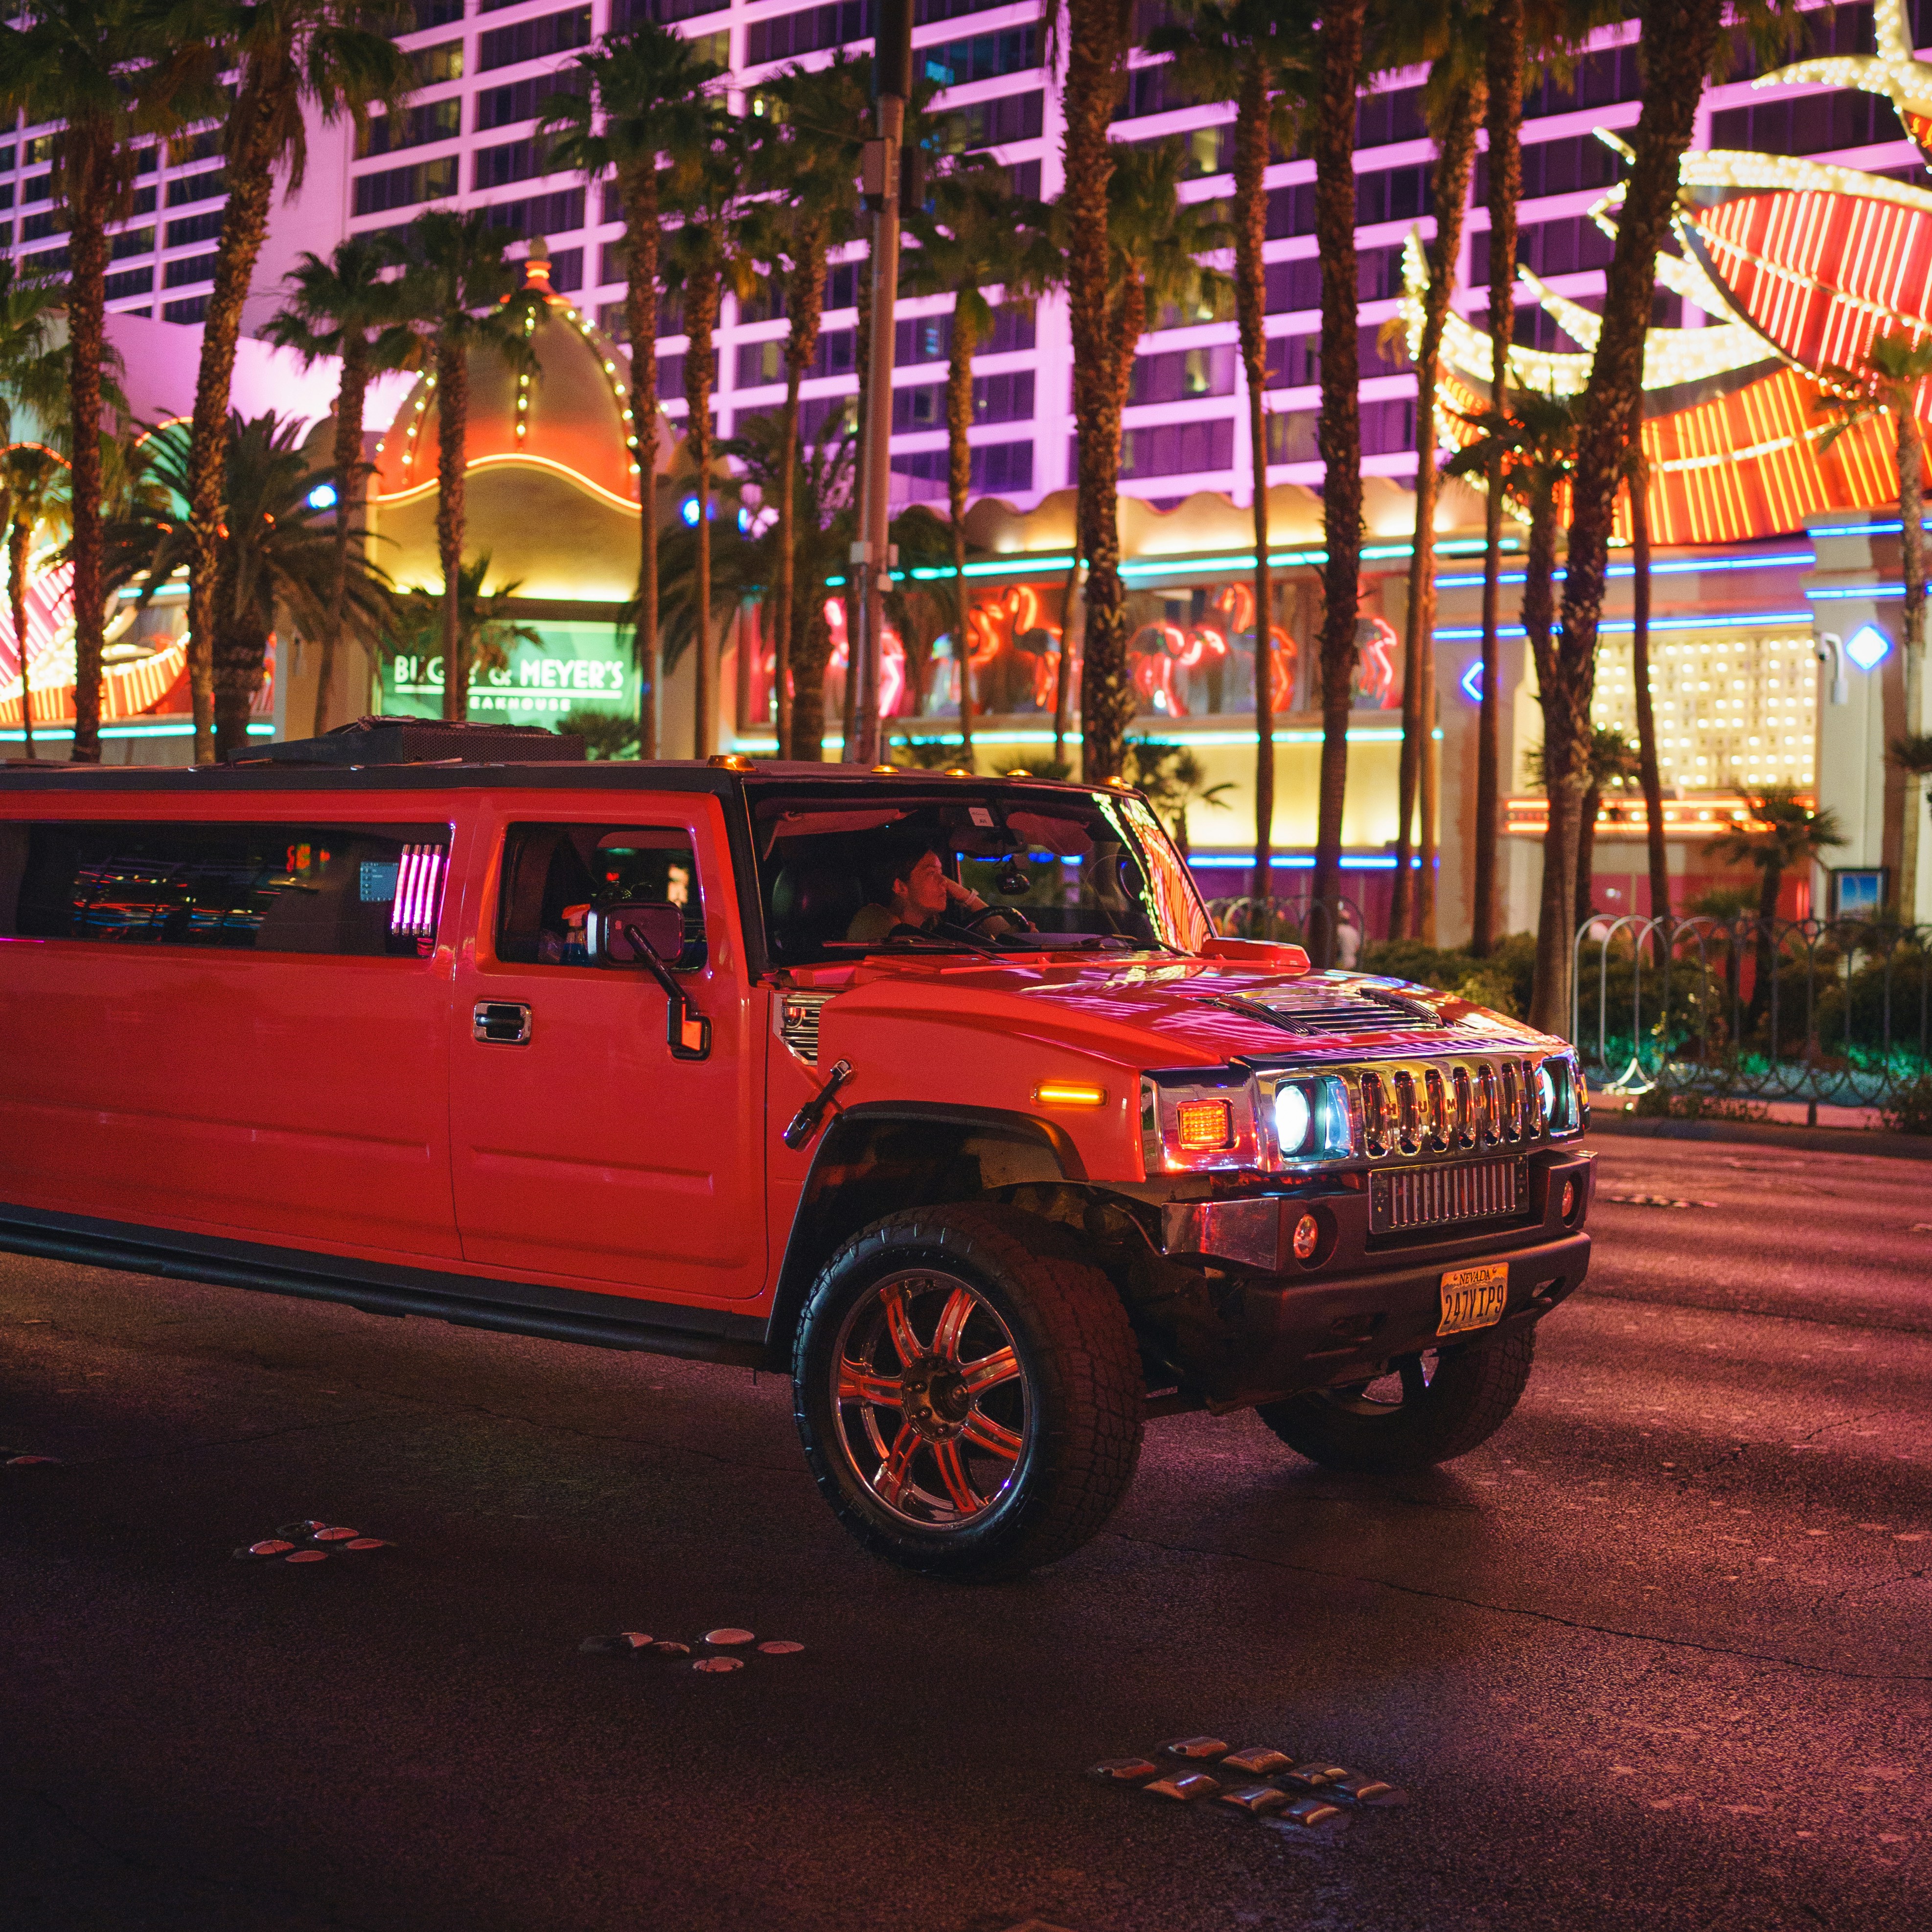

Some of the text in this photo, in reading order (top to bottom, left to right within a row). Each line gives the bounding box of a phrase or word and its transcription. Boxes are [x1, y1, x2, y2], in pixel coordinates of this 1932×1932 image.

[520, 659, 624, 689] MEYER'S
[469, 696, 572, 712] EAKHOUSE
[1460, 1269, 1490, 1285] NEVADA
